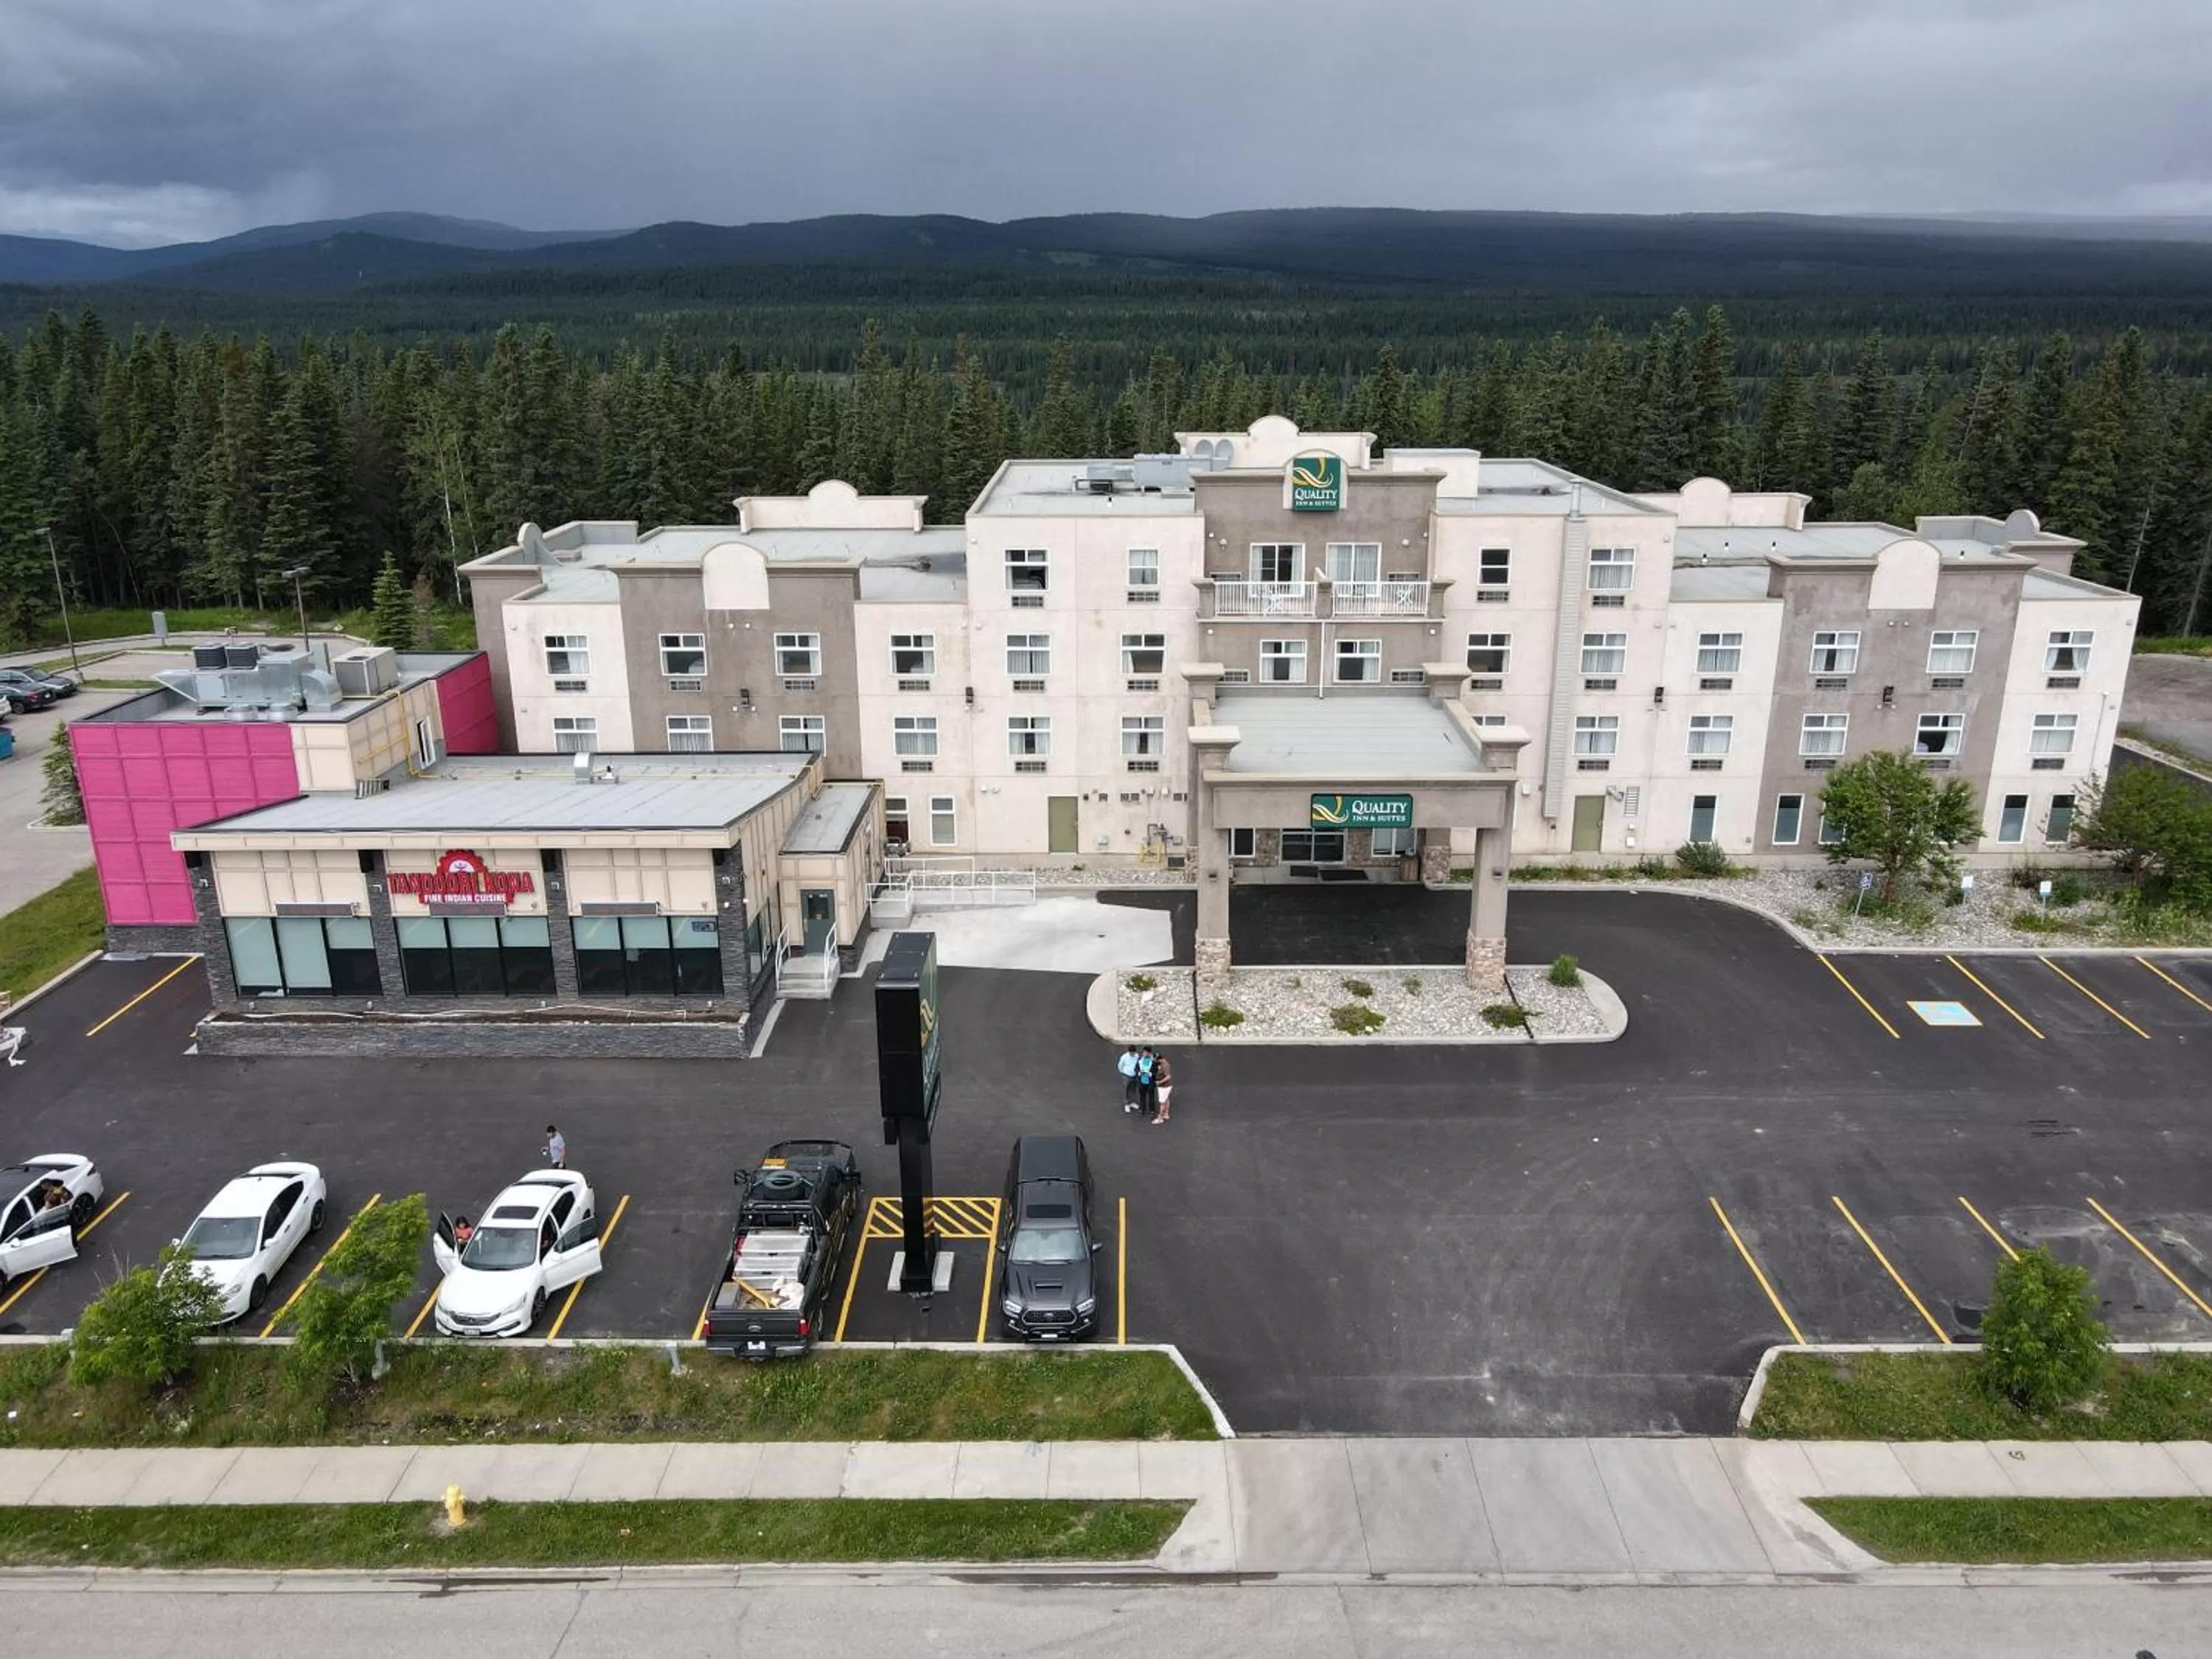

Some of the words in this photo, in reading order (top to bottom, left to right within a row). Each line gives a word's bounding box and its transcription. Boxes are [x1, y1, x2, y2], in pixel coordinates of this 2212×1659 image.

[1294, 488, 1338, 500] QUALITY
[1352, 800, 1408, 815] QUALITY
[387, 872, 479, 894] TANDOORI
[424, 894, 442, 902] FINE
[445, 894, 473, 902] INDIAN
[474, 894, 507, 902] CUISINE
